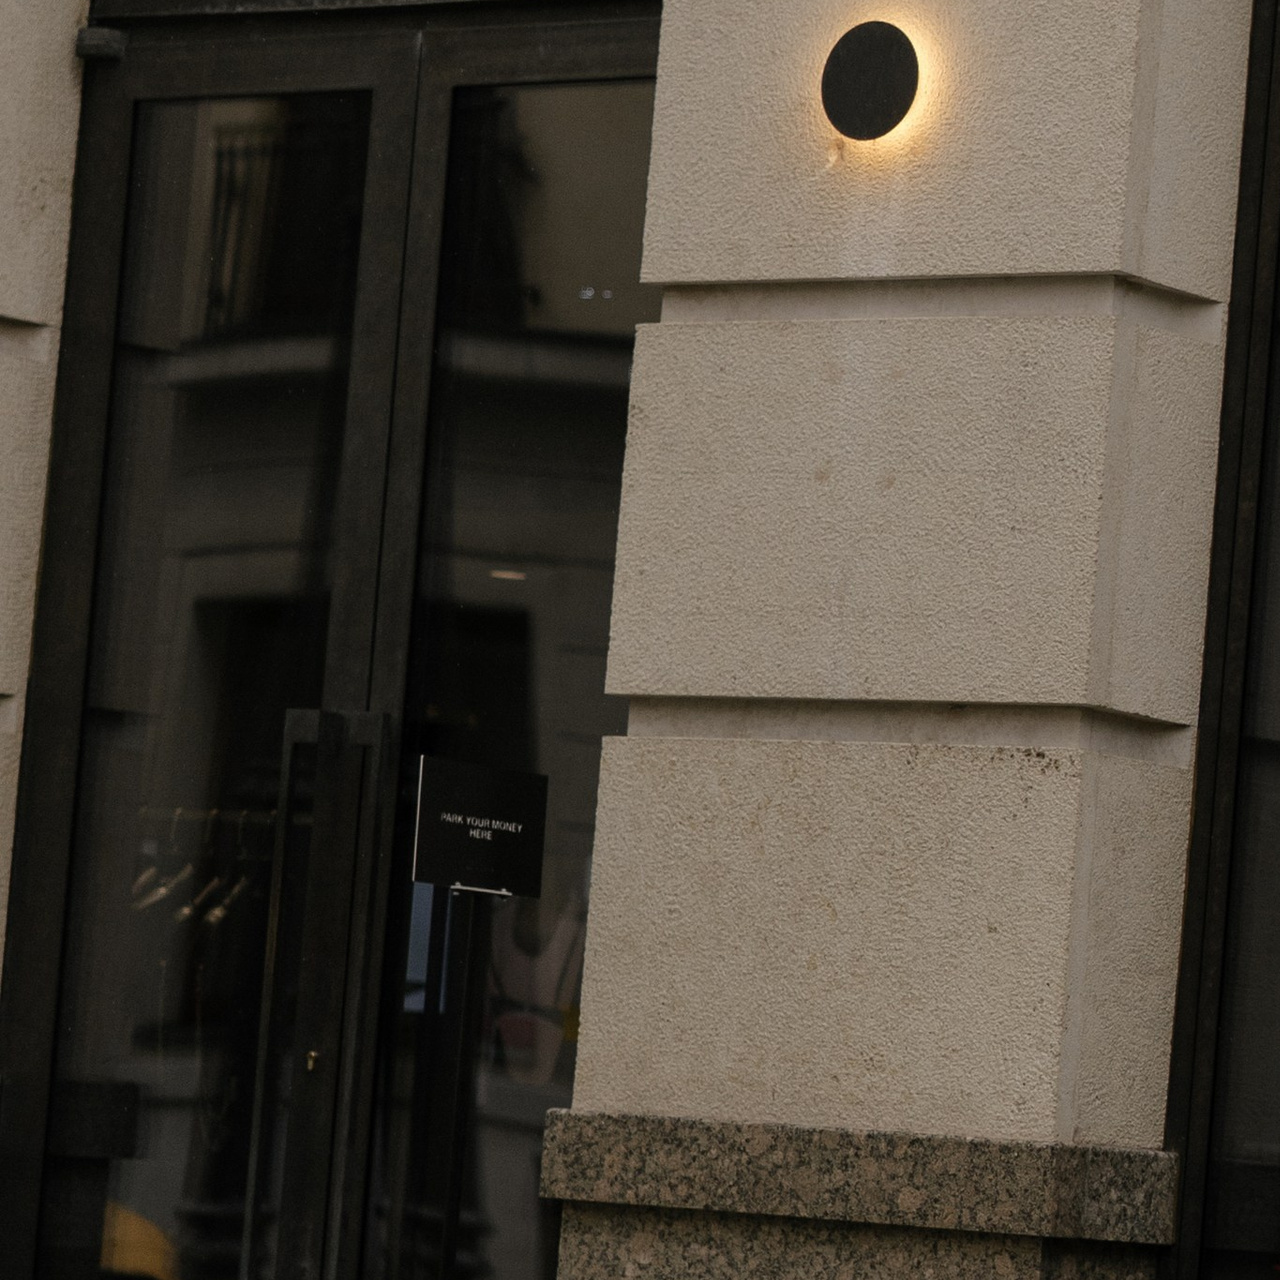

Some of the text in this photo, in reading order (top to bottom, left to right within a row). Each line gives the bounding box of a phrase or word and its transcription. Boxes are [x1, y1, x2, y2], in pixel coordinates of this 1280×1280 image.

[440, 811, 523, 834] PARK YOUR MONEY
[469, 828, 493, 841] HERE
